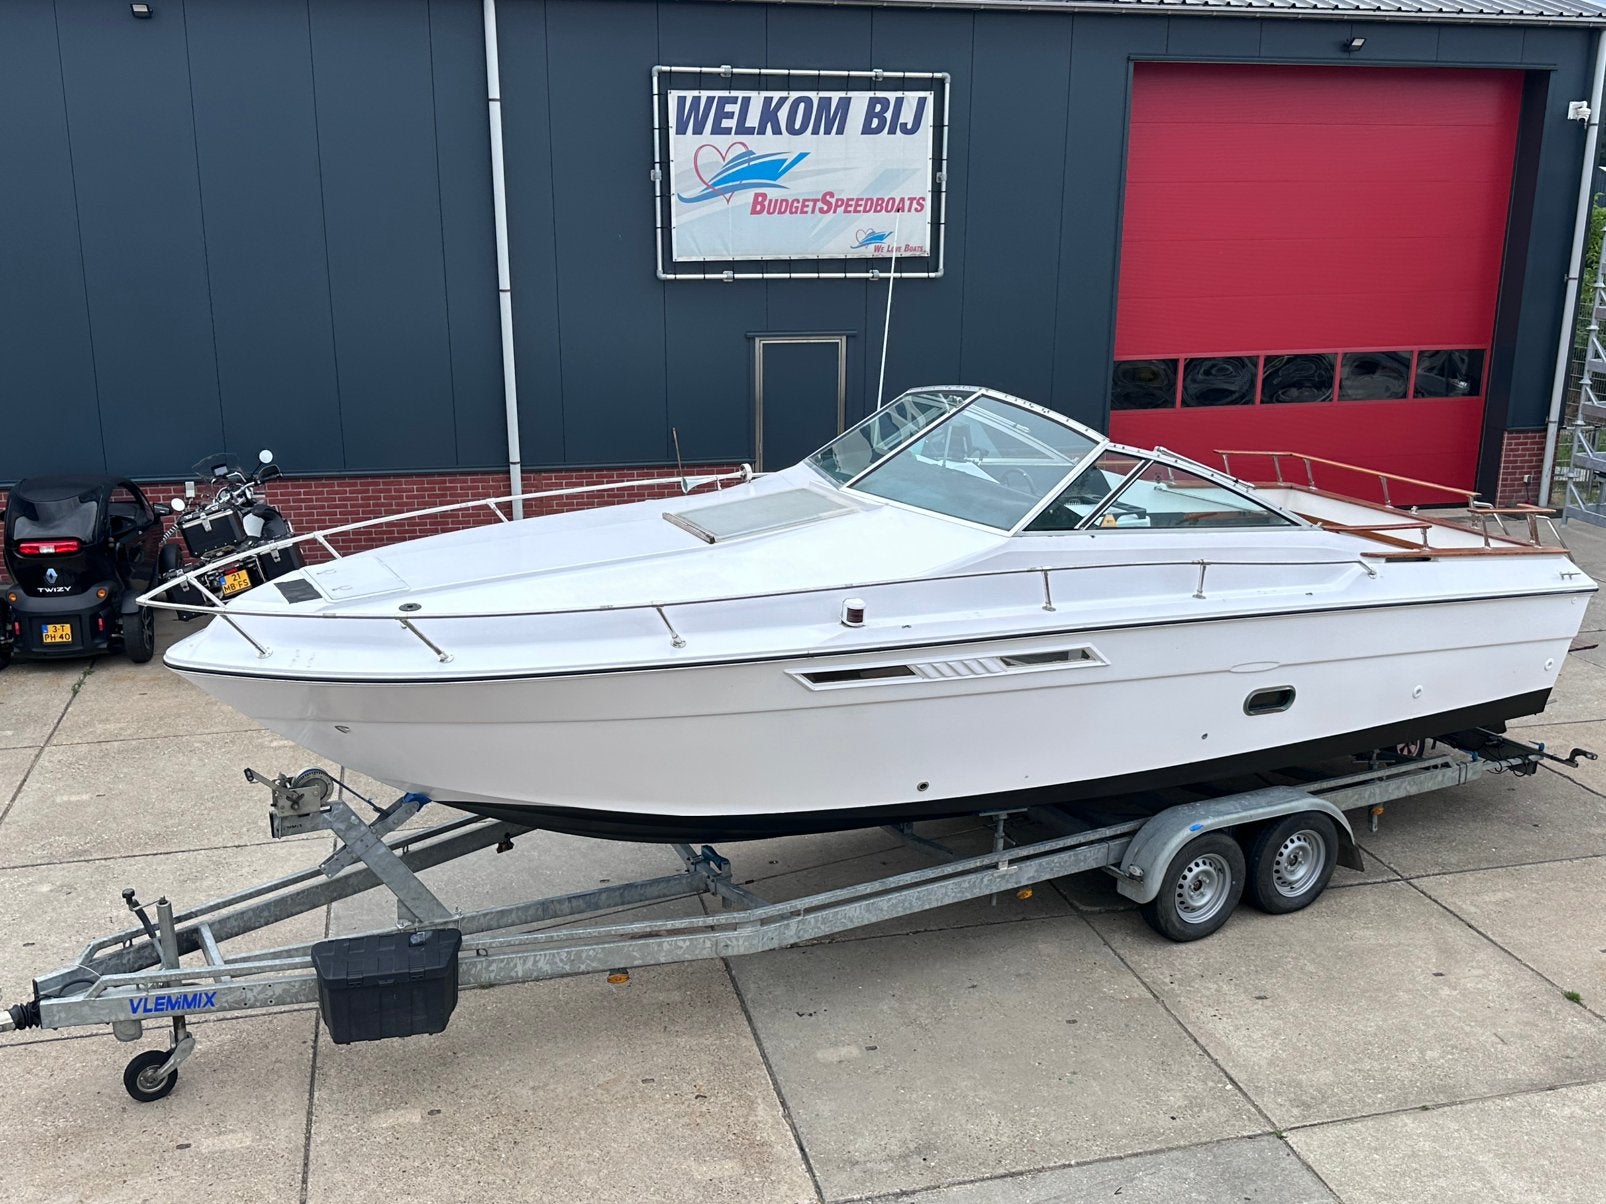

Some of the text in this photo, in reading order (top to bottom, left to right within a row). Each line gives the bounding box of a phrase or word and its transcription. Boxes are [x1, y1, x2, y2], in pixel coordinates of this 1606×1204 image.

[675, 95, 928, 136] WELKOM BIJ
[231, 573, 241, 582] 21
[36, 584, 72, 593] TWIZY
[129, 993, 217, 1014] VLEMMIX
